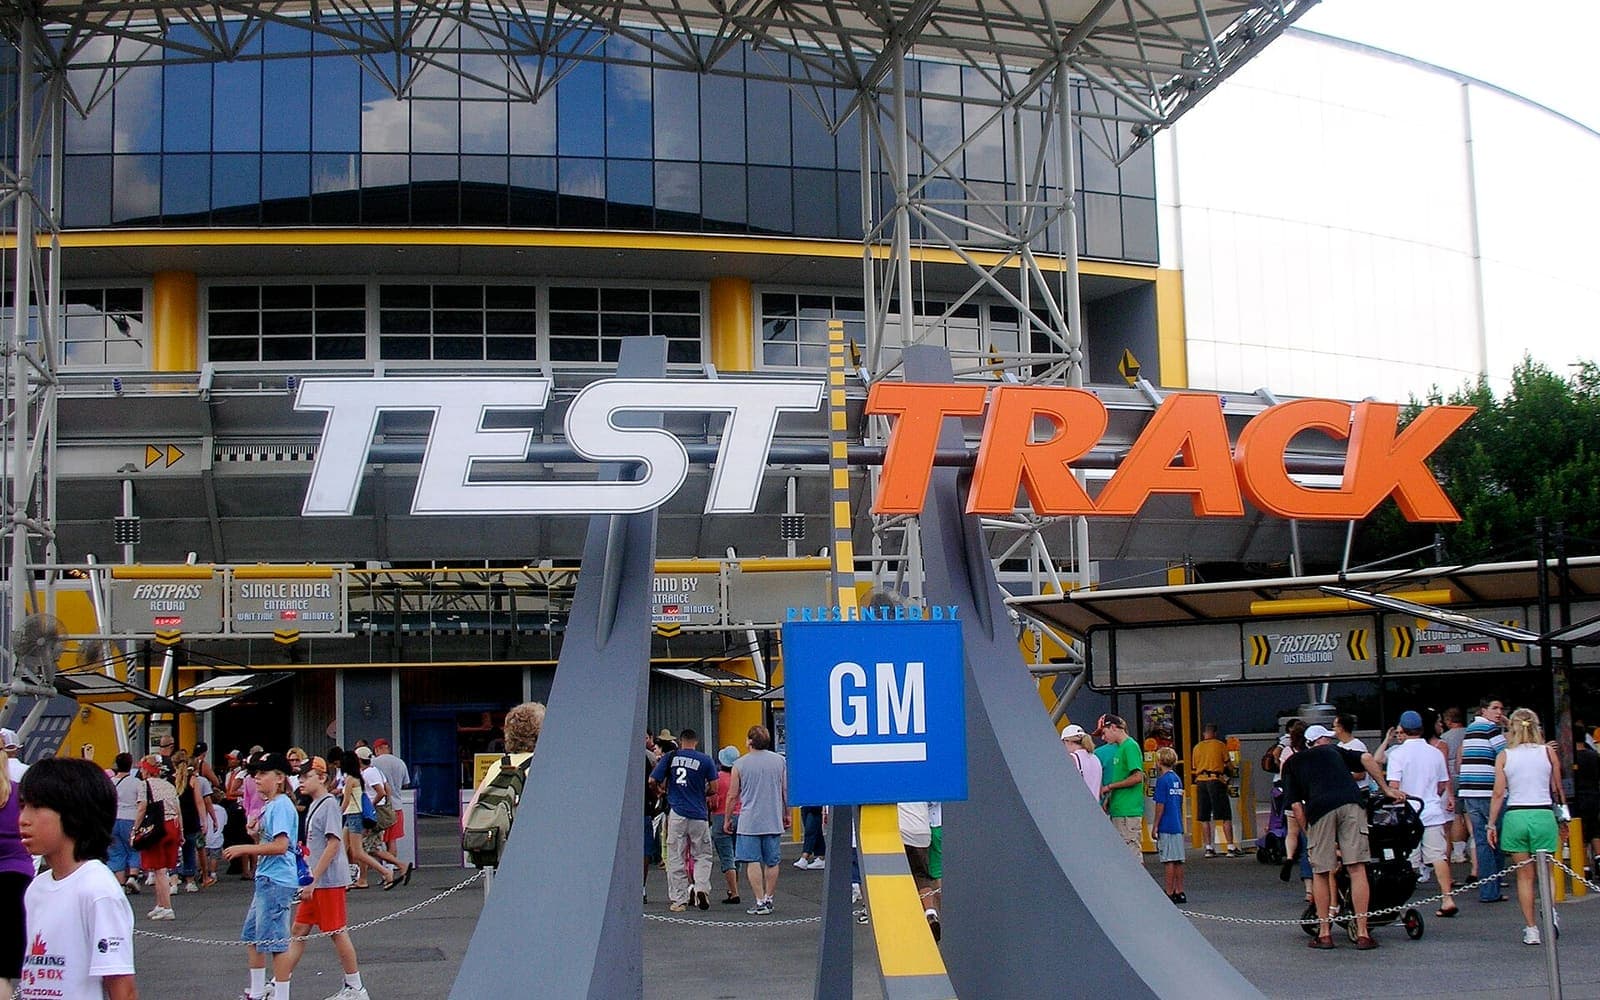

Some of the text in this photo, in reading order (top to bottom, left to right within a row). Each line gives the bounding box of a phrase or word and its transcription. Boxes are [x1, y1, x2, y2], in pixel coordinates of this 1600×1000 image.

[293, 377, 1479, 523] TEST TRACK
[133, 584, 202, 599] FASTPASS
[241, 583, 331, 598] SINGLE RIDER
[681, 577, 698, 592] BY
[150, 600, 185, 611] RETURN
[264, 600, 308, 610] ENTRANCE
[237, 613, 256, 621] WAIT
[302, 612, 335, 621] MINUTES
[787, 605, 960, 622] PRESENTED BY
[1275, 633, 1342, 654] FASTPASS
[1284, 652, 1333, 664] DISTRIBUTION
[829, 662, 926, 737] GM
[676, 767, 687, 784] 2
[38, 968, 64, 980] SOX
